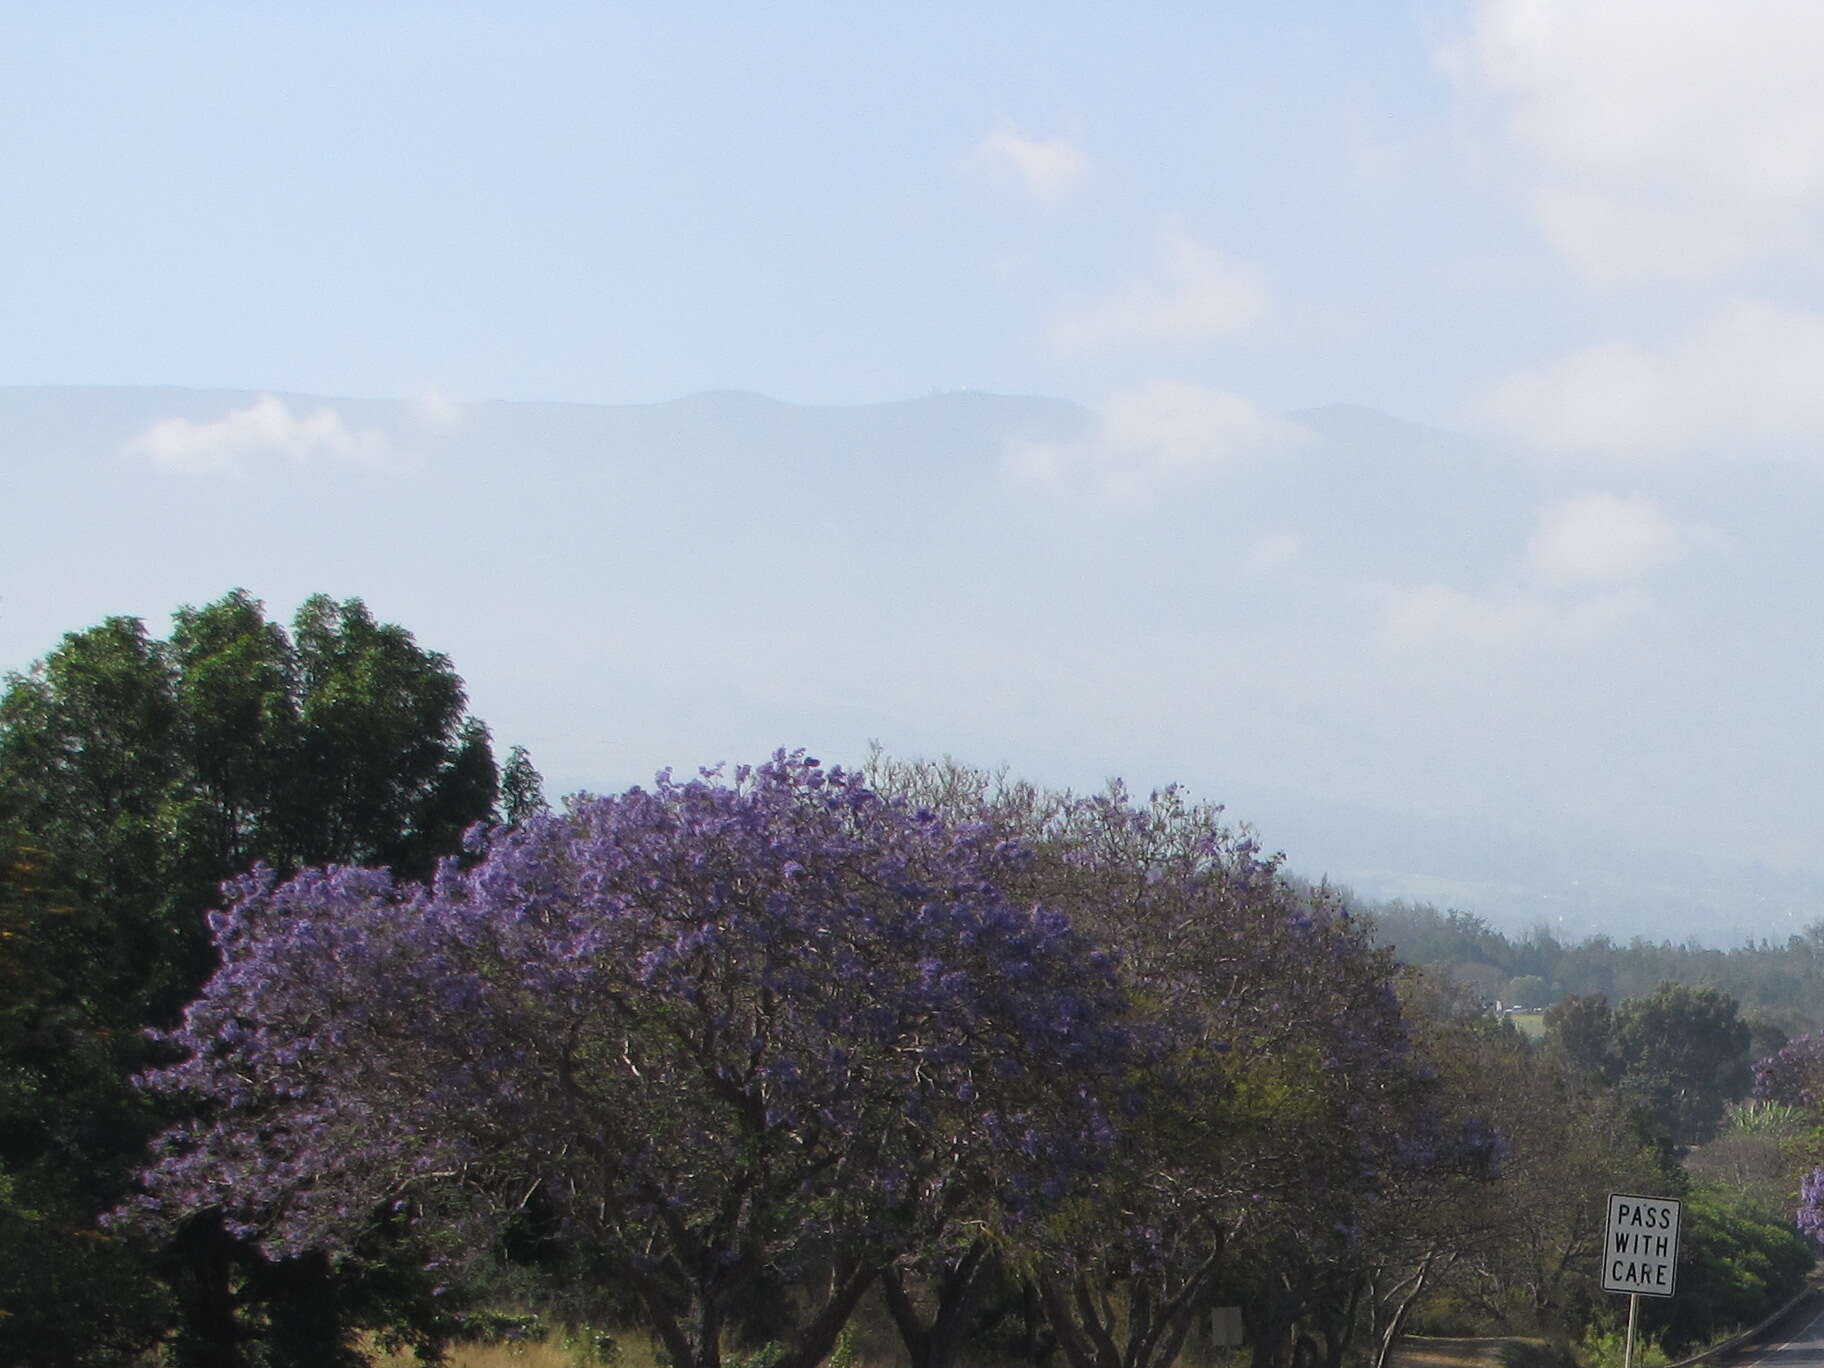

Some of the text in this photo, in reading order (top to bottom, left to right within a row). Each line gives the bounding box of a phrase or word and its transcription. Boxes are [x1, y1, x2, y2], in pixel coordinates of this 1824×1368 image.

[1618, 1204, 1671, 1229] PASS
[1615, 1232, 1668, 1257] WITH
[1612, 1260, 1667, 1285] CARE
